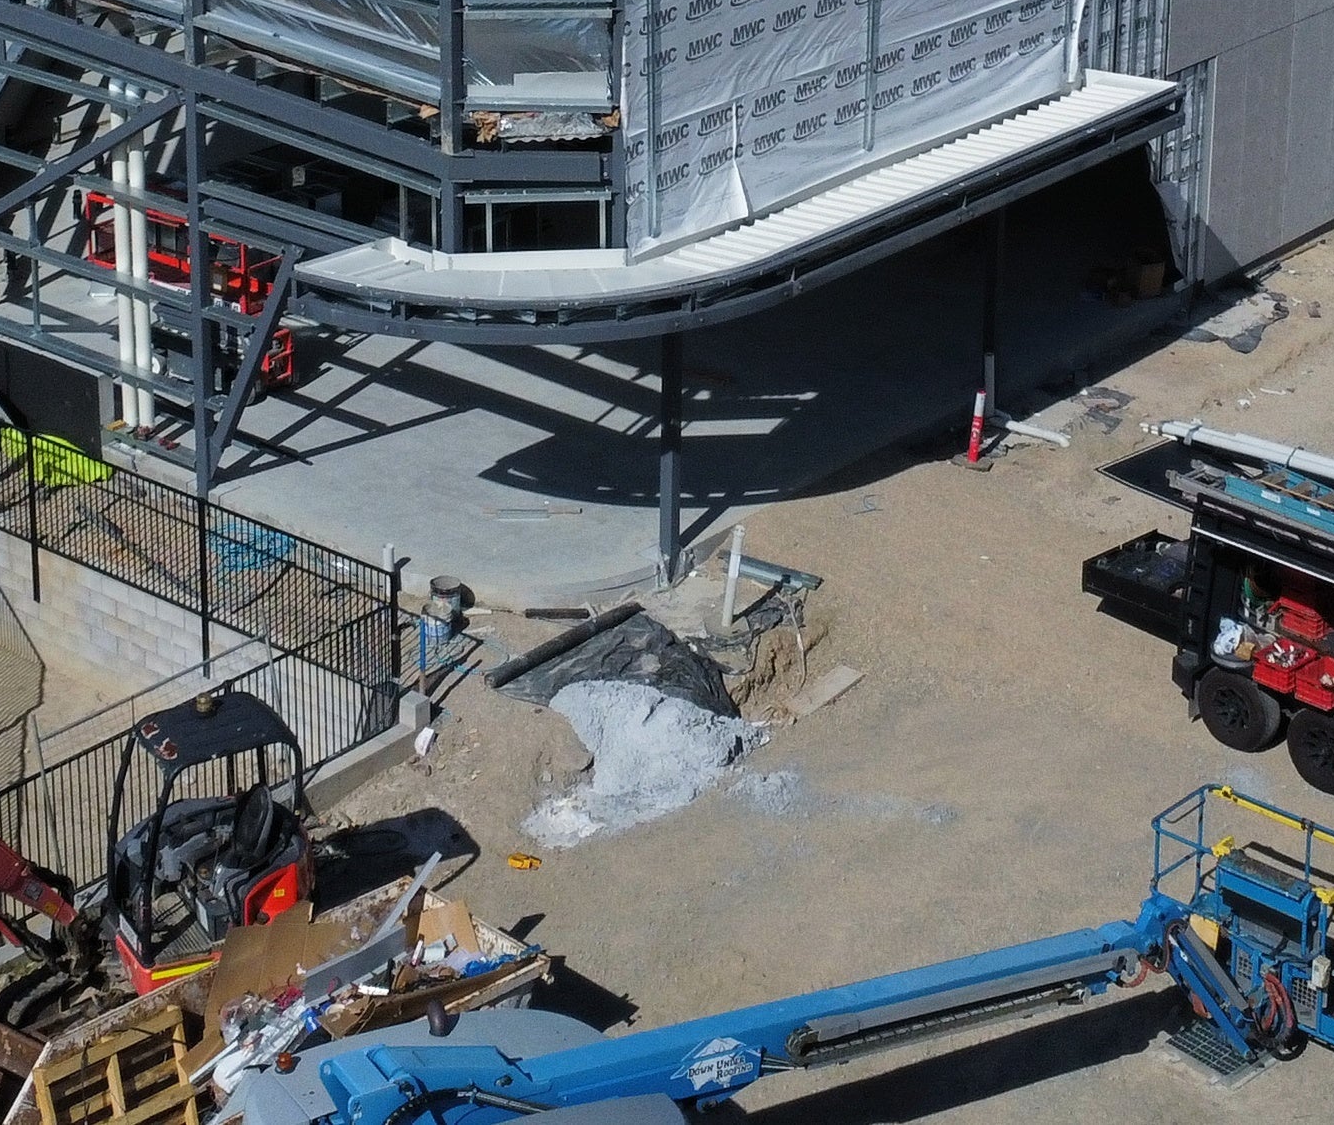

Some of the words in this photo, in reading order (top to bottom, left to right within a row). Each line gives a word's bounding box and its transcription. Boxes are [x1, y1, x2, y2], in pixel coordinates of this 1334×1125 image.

[656, 123, 689, 150] MWC
[755, 89, 786, 114] MWC
[797, 75, 827, 100] MWC
[838, 62, 867, 85] MWC
[876, 47, 905, 70] MWC
[914, 34, 942, 56] MWC
[951, 22, 978, 44] MWC
[986, 10, 1013, 31] MWC
[689, 32, 723, 58] MWC
[733, 18, 766, 44] MWC
[775, 4, 807, 30] MWC
[656, 162, 690, 189] MWC
[755, 127, 786, 153] MWC
[796, 113, 827, 138] MWC
[836, 99, 866, 123] MWC
[875, 84, 904, 108] MWC
[913, 70, 941, 93] MWC
[950, 57, 977, 79] MWC
[985, 45, 1011, 67] MWC
